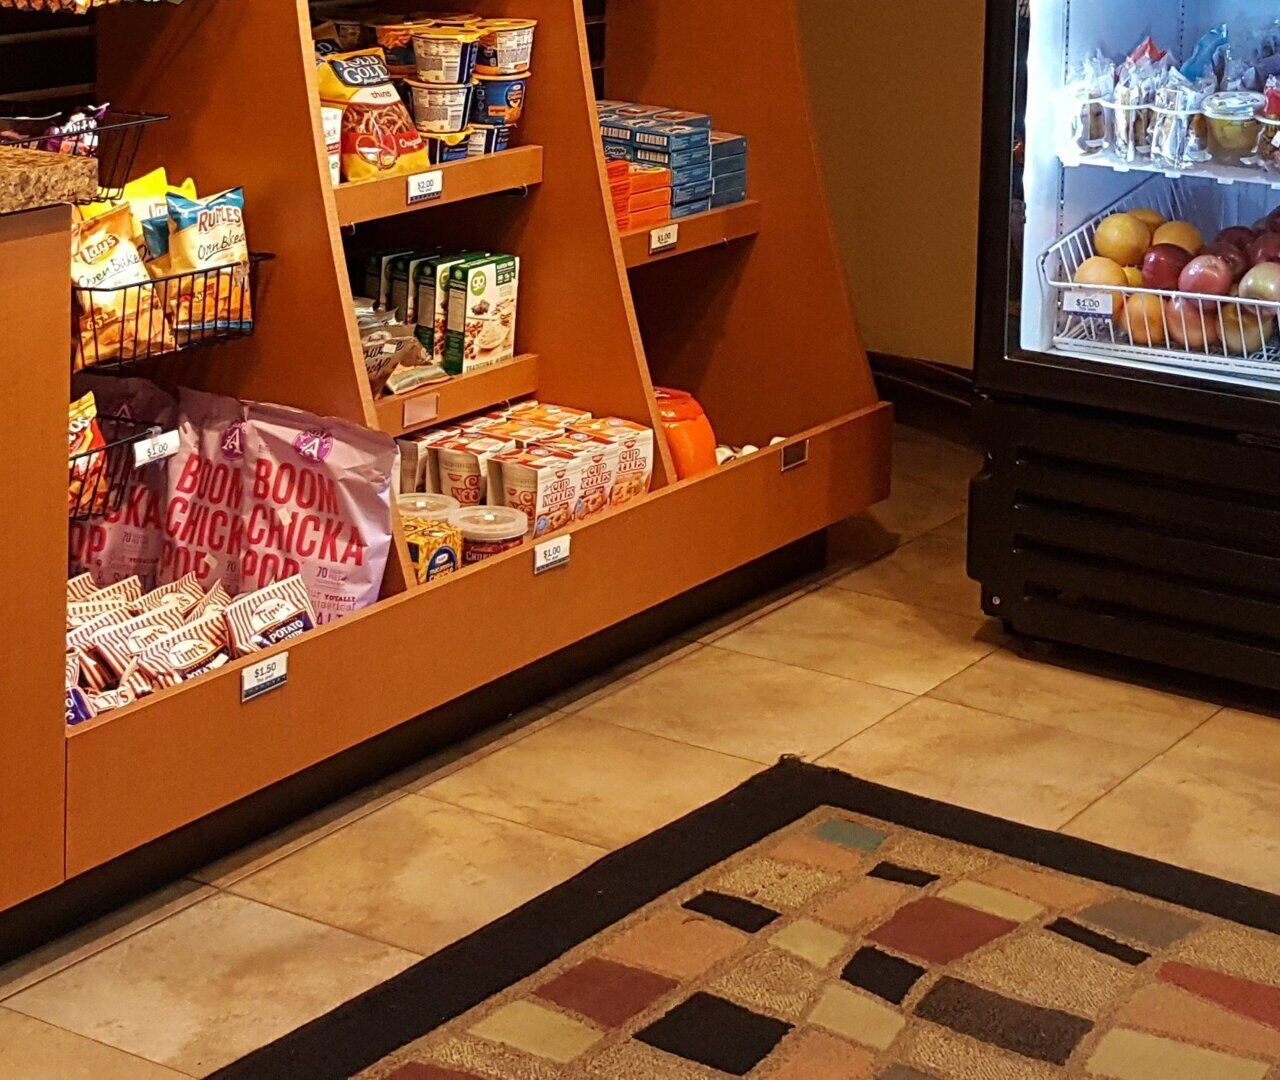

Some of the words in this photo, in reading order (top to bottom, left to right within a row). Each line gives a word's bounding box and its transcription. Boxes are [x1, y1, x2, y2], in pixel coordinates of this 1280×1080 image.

[343, 66, 388, 84] GOLD
[371, 91, 392, 99] thins
[1075, 298, 1101, 309] $1.00
[147, 442, 168, 457] $1.00
[619, 449, 641, 465] CUP
[587, 462, 607, 478] CUP
[253, 457, 340, 516] BOOM
[551, 478, 570, 495] CUP
[580, 471, 611, 490] NOODLES
[542, 487, 576, 507] NOODLES
[247, 503, 364, 567] CHICKA
[543, 545, 561, 558] $1.00
[129, 625, 168, 650] Tim's
[269, 619, 304, 643] POTATO
[171, 639, 210, 668] Tim's
[254, 661, 278, 679] $1.50
